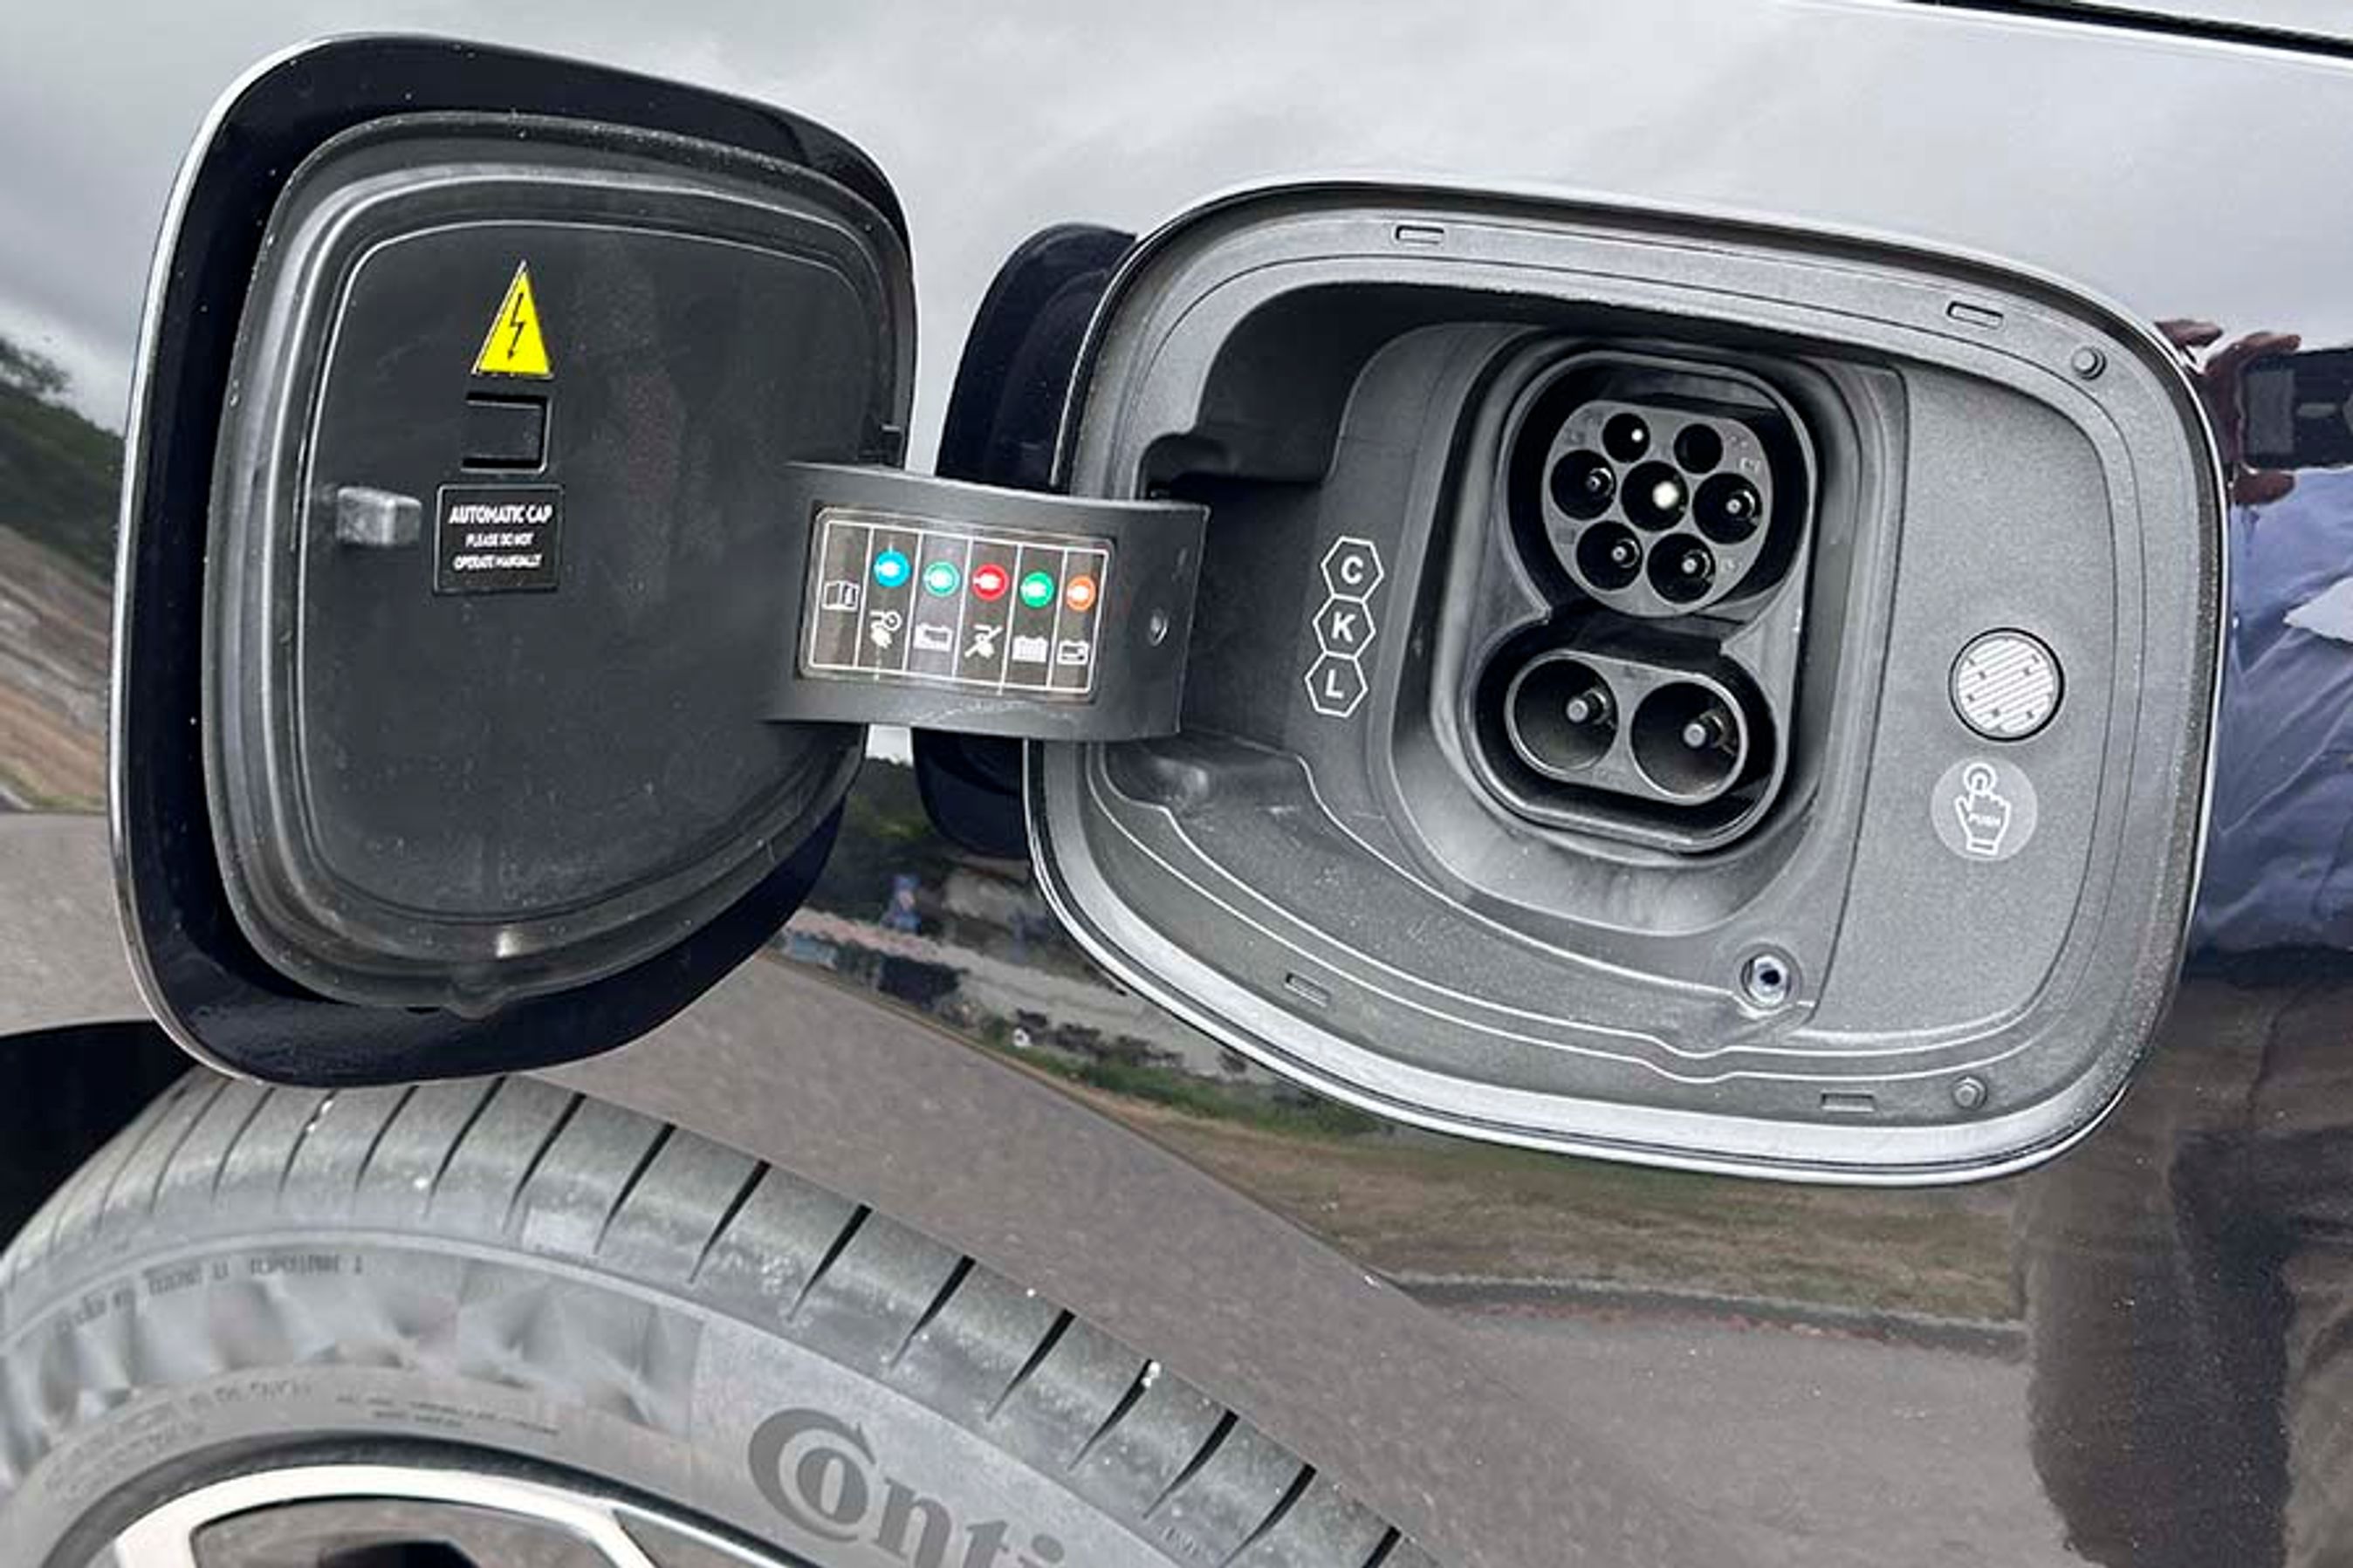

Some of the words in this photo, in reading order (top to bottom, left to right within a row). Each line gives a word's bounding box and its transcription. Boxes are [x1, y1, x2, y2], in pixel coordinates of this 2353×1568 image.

[449, 504, 525, 524] AUTOMATIC
[525, 503, 553, 524] CAP
[1341, 555, 1364, 585] C
[1332, 611, 1356, 642] K
[1325, 668, 1345, 699] L
[1968, 812, 2001, 827] PUSH
